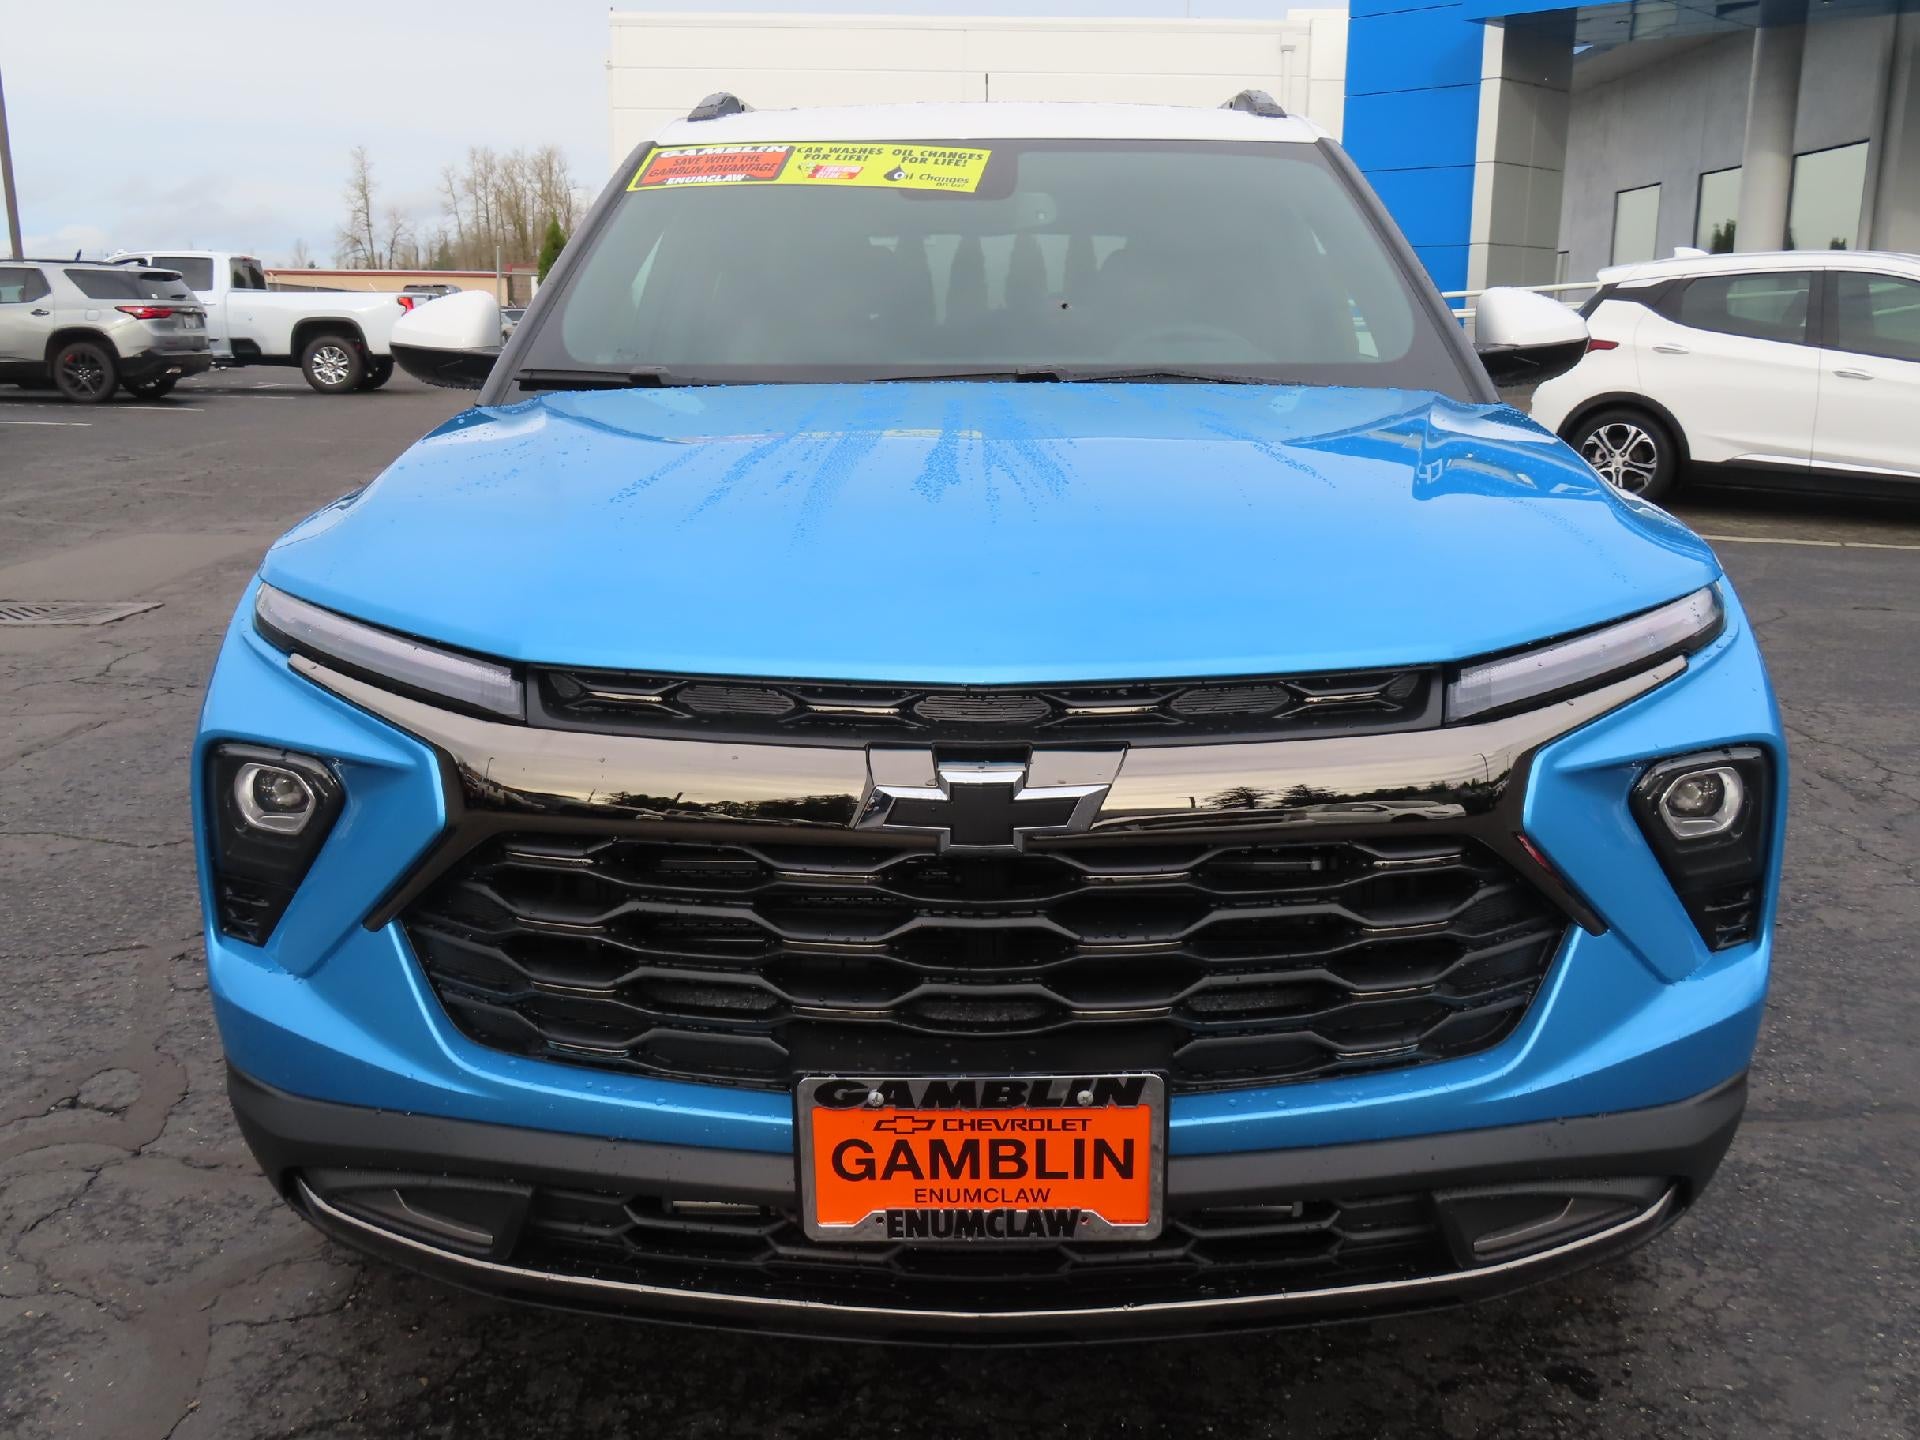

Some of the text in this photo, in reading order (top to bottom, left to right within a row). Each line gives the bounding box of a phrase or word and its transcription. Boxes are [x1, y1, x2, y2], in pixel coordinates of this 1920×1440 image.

[660, 145, 790, 158] GAMBLIN
[829, 147, 884, 155] WASHES
[892, 148, 984, 160] OIL CHANGES
[673, 155, 761, 166] SAVE WITH THE
[835, 154, 869, 162] LIFE!
[901, 156, 968, 168] FOR LIFE!
[649, 163, 777, 177] GAMBLIN ADVANTAGE
[665, 174, 745, 185] ENUMCLAW
[918, 173, 970, 184] Changes
[813, 1078, 1147, 1109] GAMBLIN
[943, 1118, 1093, 1132] CHEVROLET
[831, 1138, 1134, 1181] GAMBLIN
[914, 1188, 1051, 1203] ENUMCLAW
[887, 1209, 1080, 1240] ENUMCLAW
